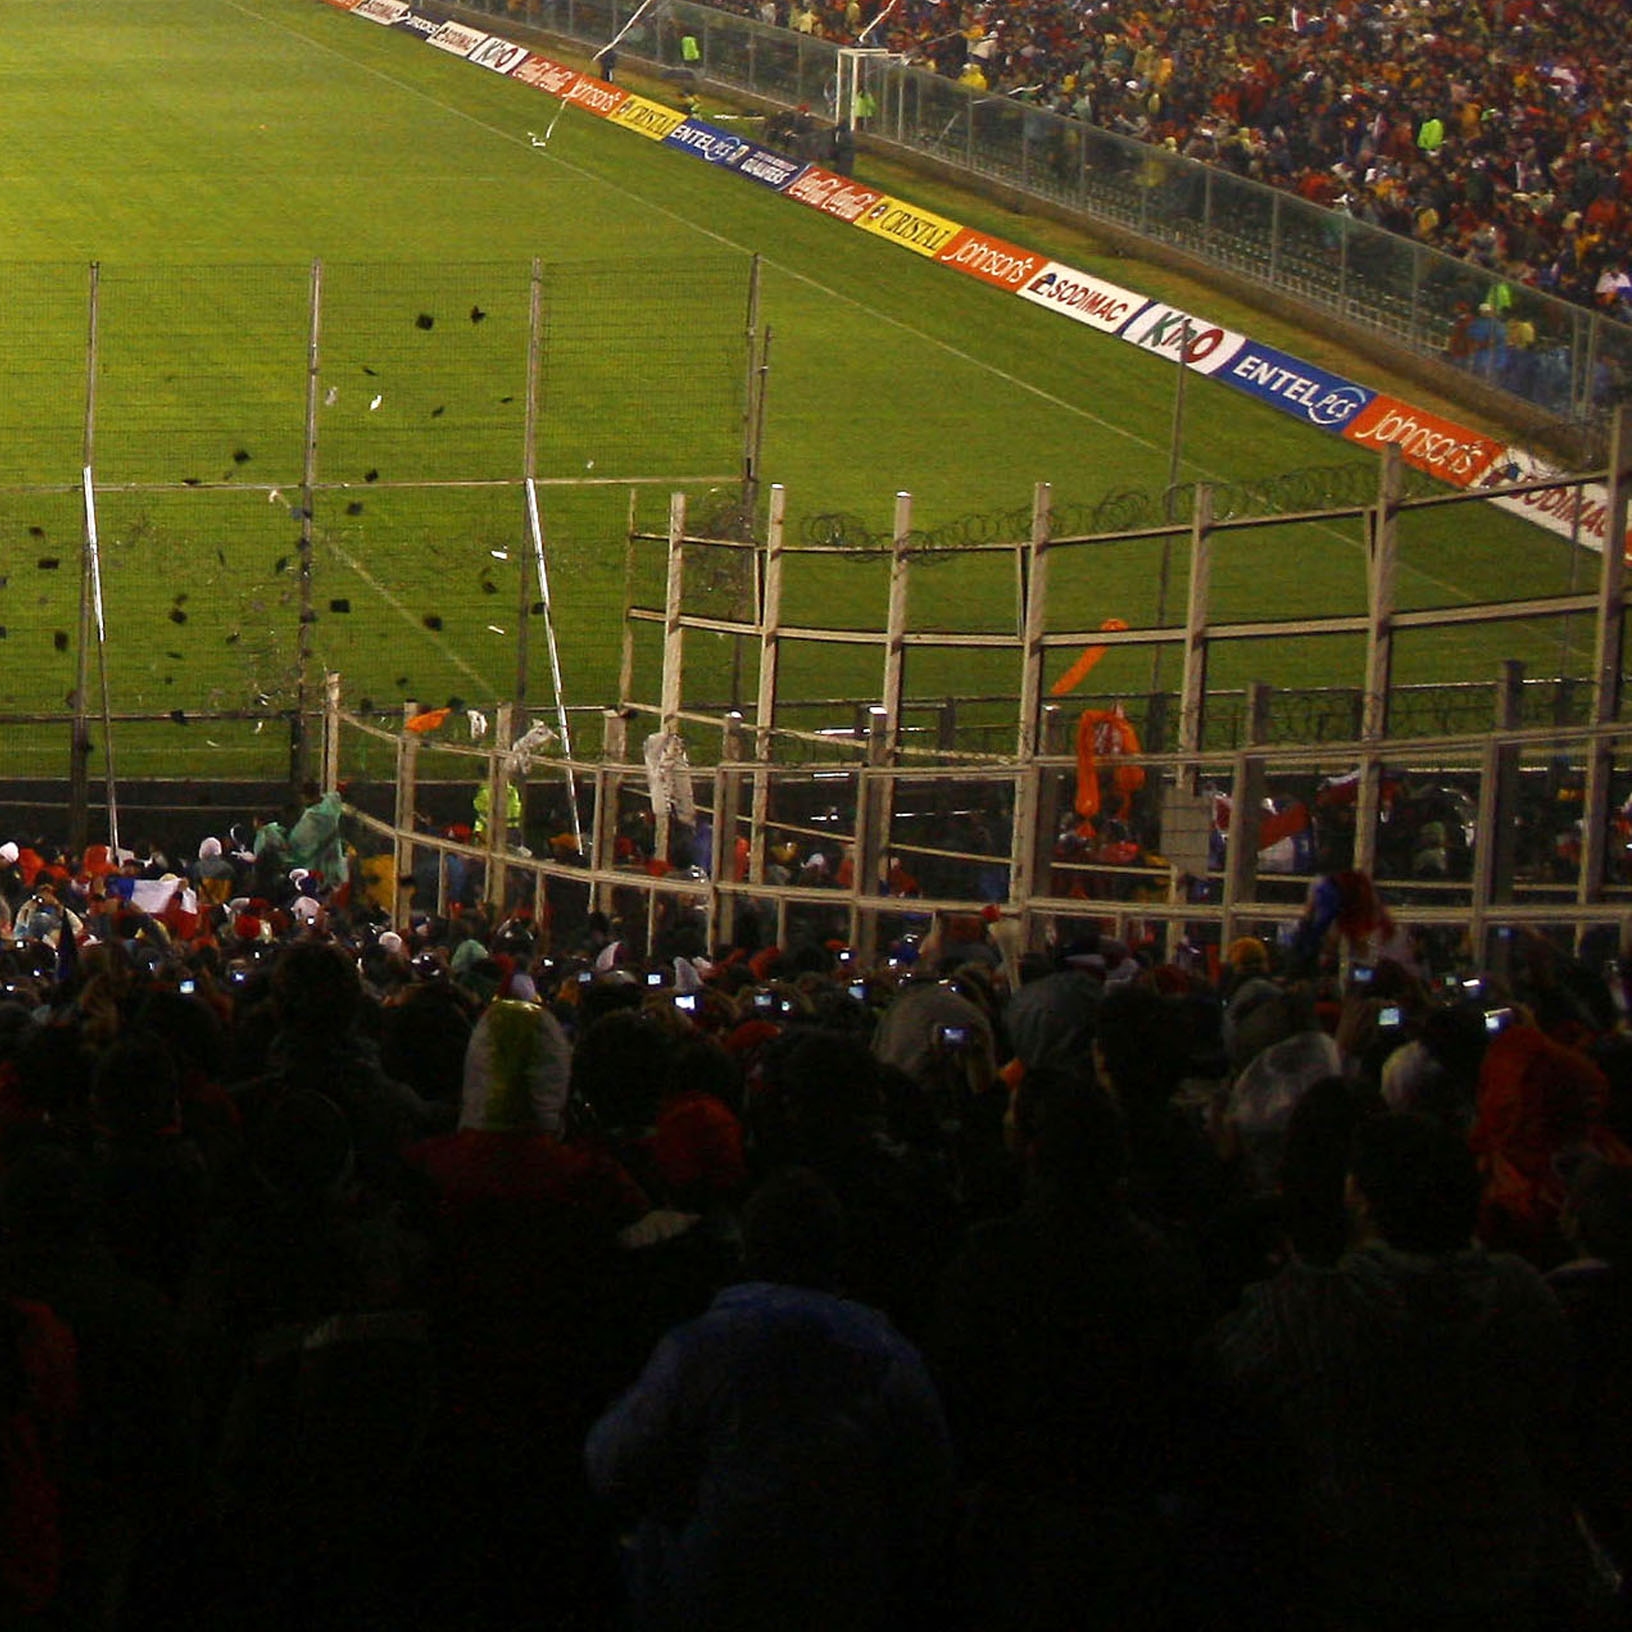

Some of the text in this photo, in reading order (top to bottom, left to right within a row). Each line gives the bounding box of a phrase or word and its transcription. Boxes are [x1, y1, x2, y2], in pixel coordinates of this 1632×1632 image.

[669, 124, 716, 154] ENTEL
[879, 209, 951, 251] CRISTAL
[941, 238, 1033, 284] Johnson's
[1047, 279, 1129, 323] SODIMAC
[1233, 354, 1358, 420] ENTEL PCS
[1354, 407, 1487, 476] Johnson's
